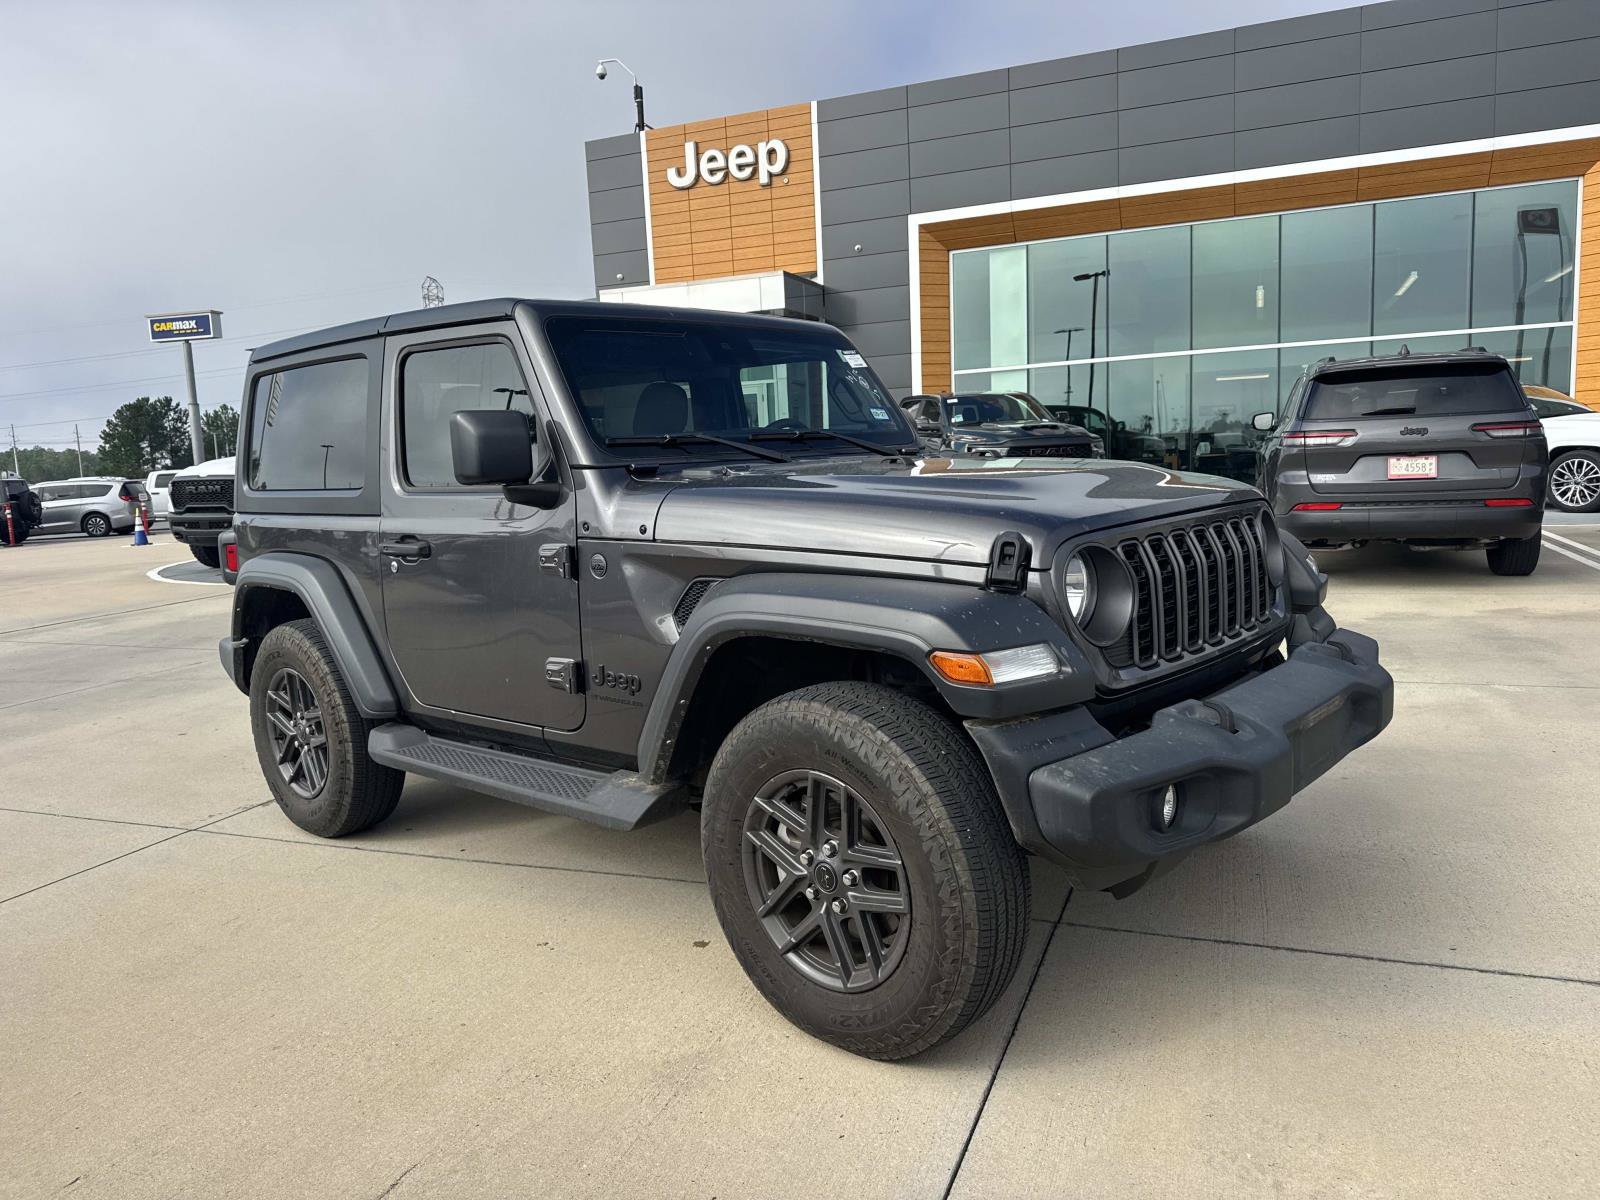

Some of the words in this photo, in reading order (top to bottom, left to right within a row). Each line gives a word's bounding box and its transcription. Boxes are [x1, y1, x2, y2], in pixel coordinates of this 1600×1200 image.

[666, 139, 789, 190] Jeep
[1399, 426, 1429, 436] Jeep
[184, 485, 222, 495] RAM
[591, 664, 642, 696] Jeep
